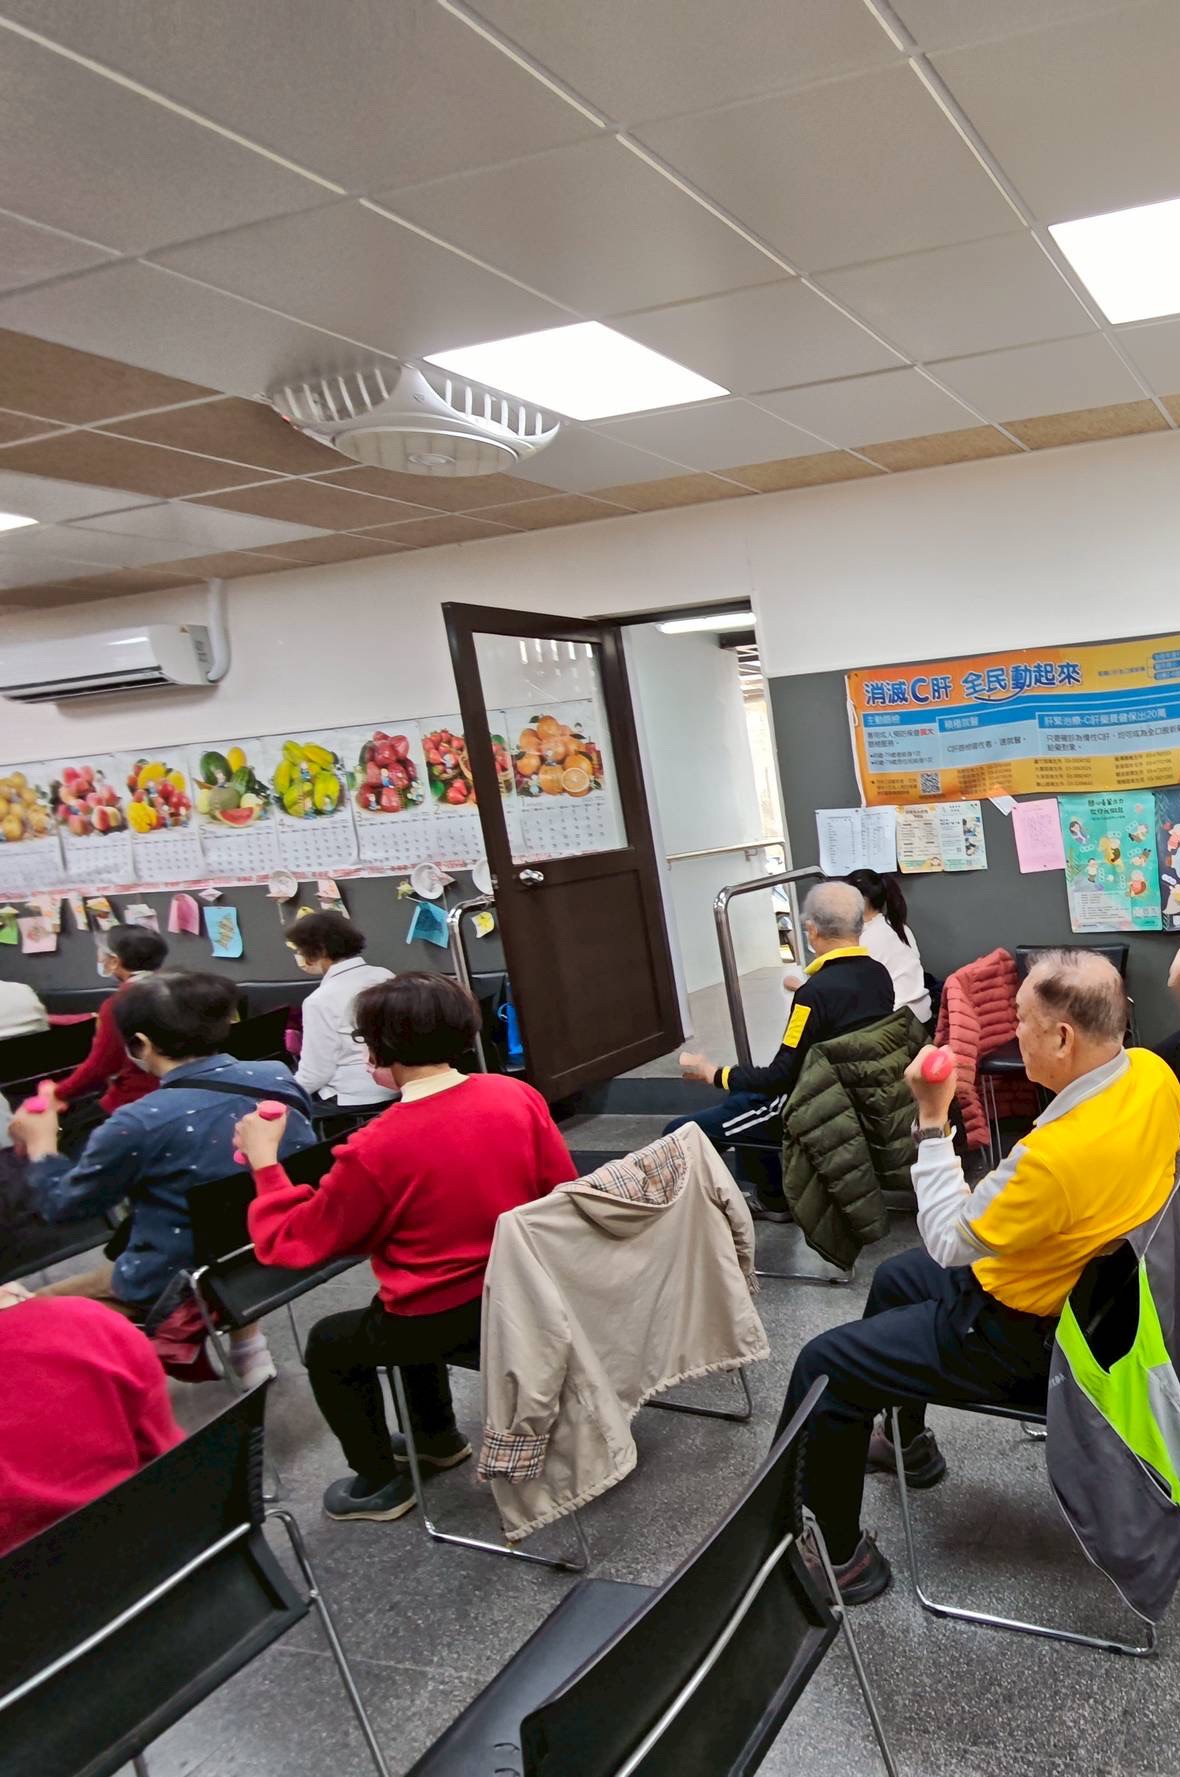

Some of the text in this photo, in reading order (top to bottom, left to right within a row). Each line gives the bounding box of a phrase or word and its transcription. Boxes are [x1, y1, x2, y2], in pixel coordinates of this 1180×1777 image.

[864, 661, 1083, 706] 消滅C肝 全民動起來
